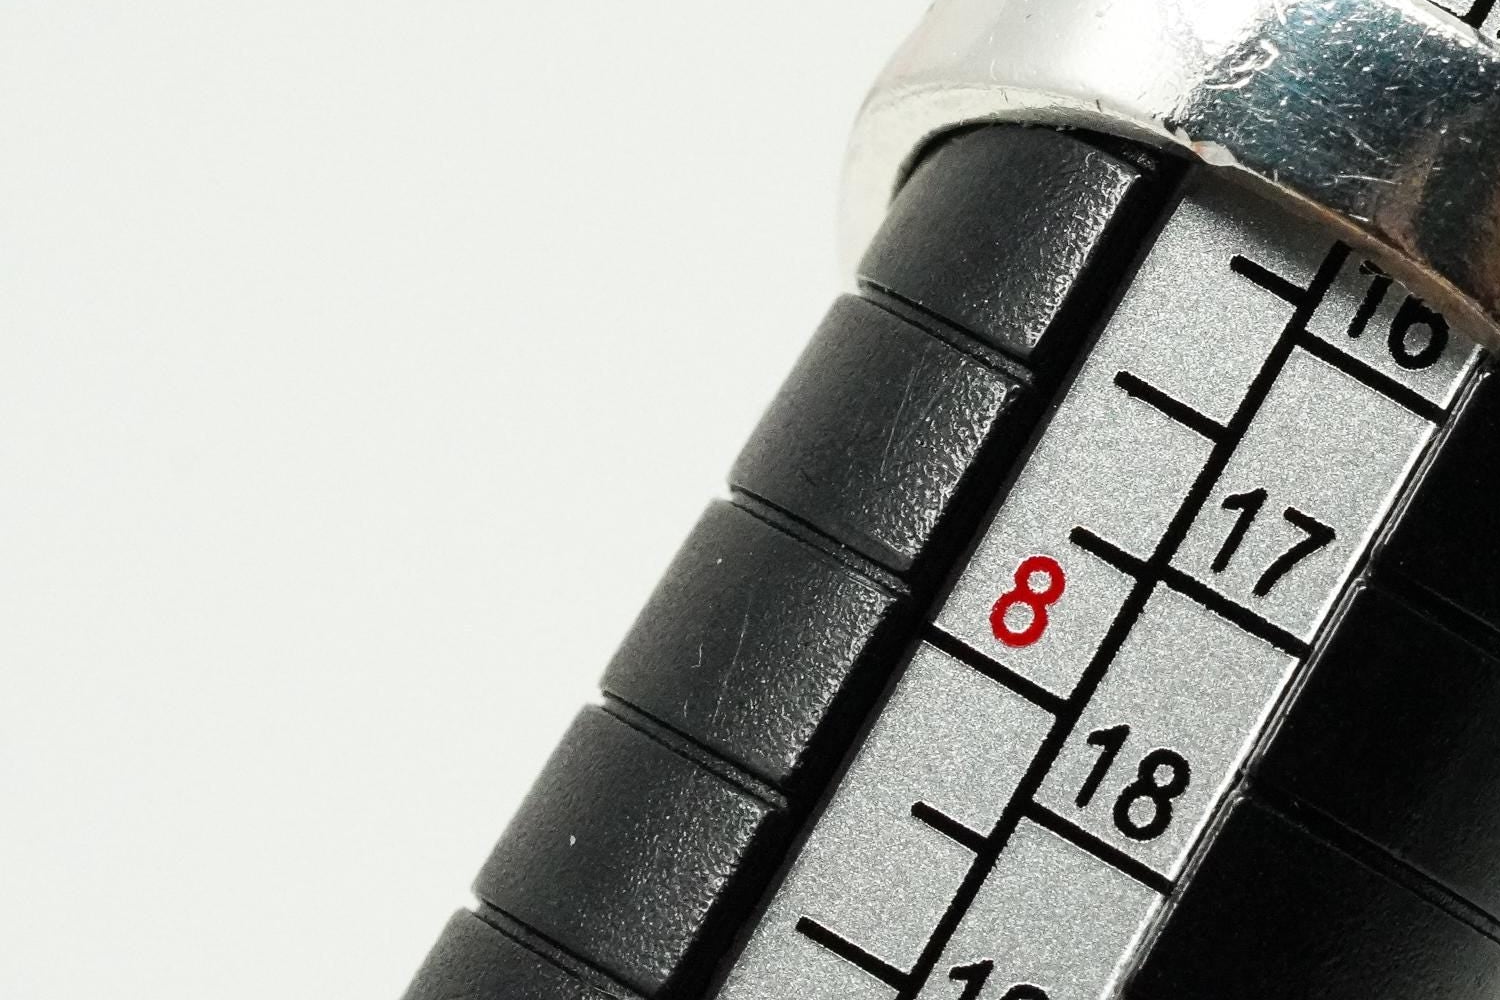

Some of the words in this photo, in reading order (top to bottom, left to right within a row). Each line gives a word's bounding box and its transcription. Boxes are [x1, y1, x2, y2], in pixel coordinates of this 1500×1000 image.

[1346, 260, 1450, 371] 16
[1210, 488, 1336, 598] 17
[989, 556, 1066, 648] 8
[1075, 724, 1191, 842] 18
